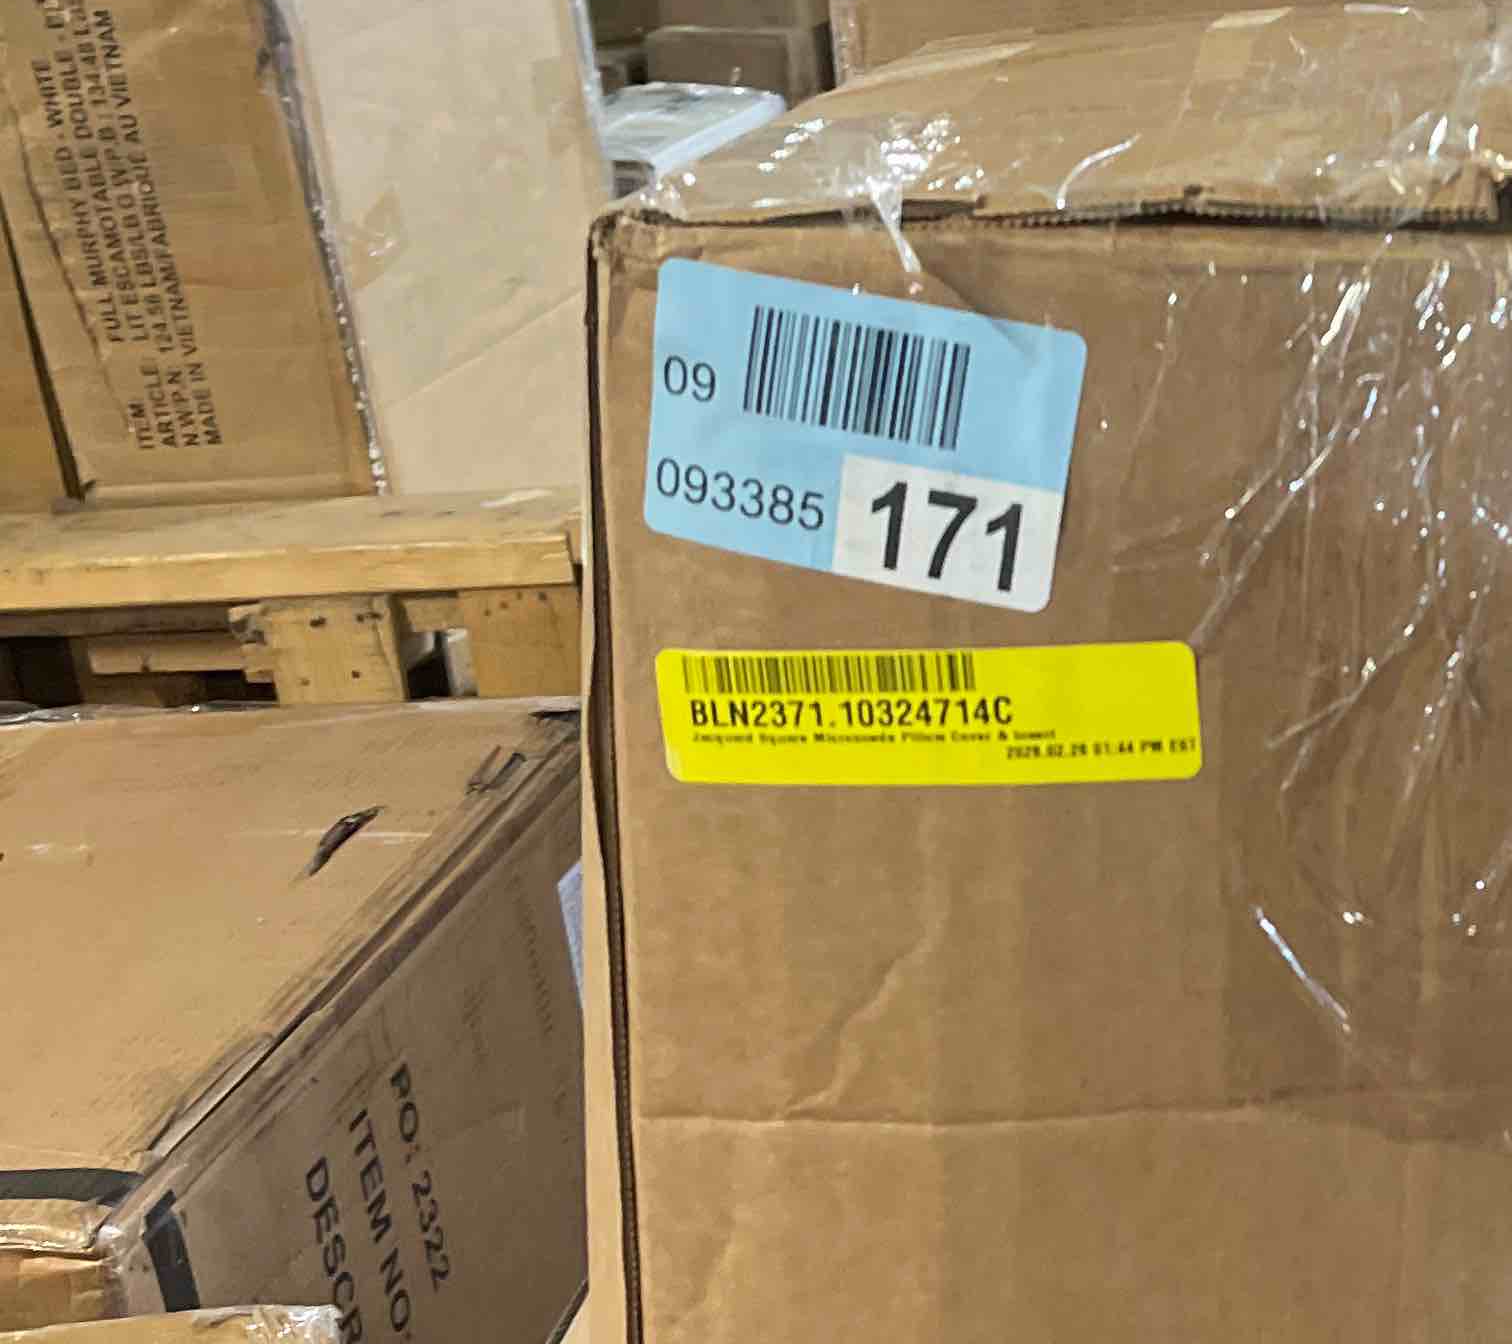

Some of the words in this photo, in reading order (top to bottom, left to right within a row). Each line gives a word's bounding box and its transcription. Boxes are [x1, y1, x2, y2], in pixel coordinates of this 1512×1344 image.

[94, 10, 131, 107] VIETNAM
[32, 61, 63, 127] WHITE
[54, 52, 92, 138] DOUBLE
[119, 115, 138, 142] AU
[56, 147, 79, 190] BED
[71, 199, 107, 286] MURPHY
[84, 146, 138, 305] ESCAMOTABLE
[98, 295, 123, 342] FULL
[185, 363, 205, 381] IN
[662, 355, 717, 403] 09
[193, 388, 221, 443] MADE
[655, 457, 825, 532] 093385
[870, 481, 1024, 592] 171
[689, 695, 1014, 729] BLN2371.10324714C
[348, 1108, 393, 1245] ITEM
[411, 1170, 451, 1293] 2322
